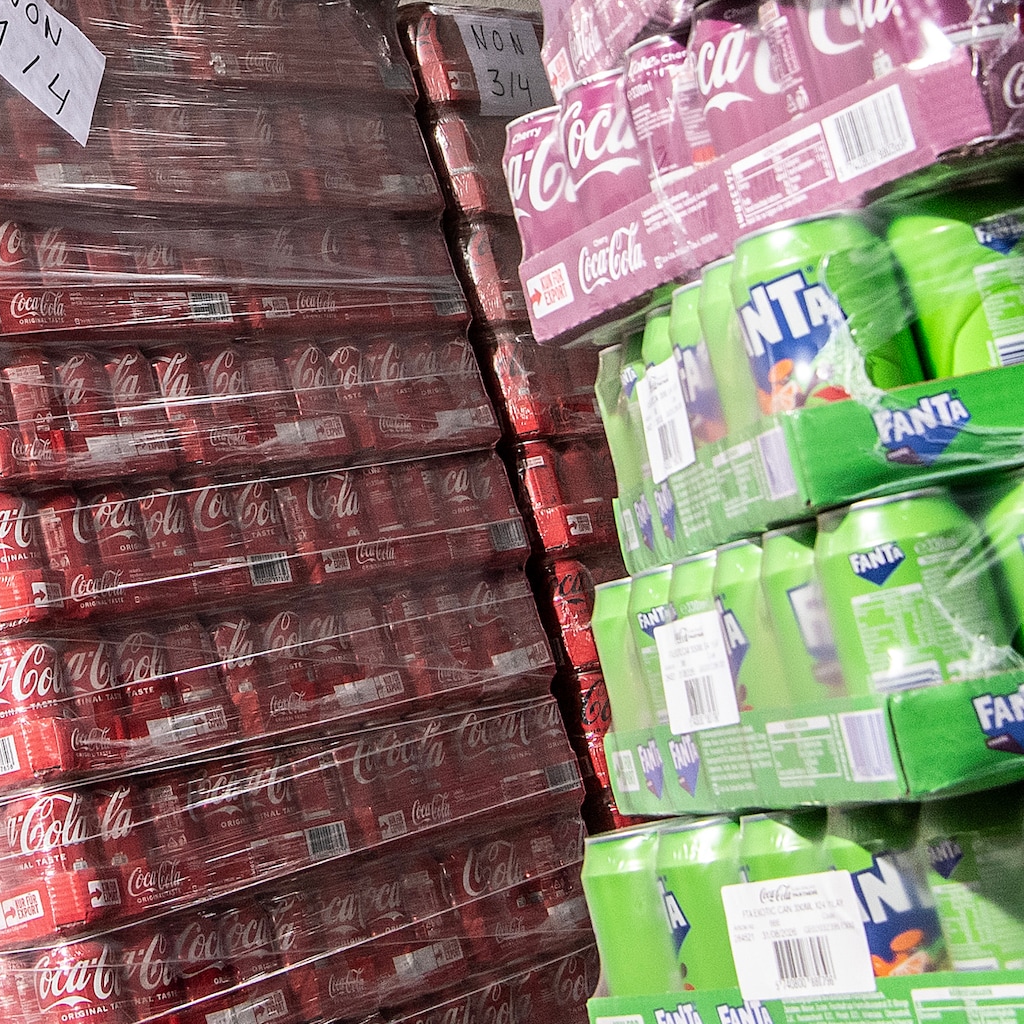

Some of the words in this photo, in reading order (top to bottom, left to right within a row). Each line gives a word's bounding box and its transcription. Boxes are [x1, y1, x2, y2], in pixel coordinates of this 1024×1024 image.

[471, 25, 525, 57] NON
[512, 126, 542, 145] Cherry
[578, 222, 647, 295] Coca-Cola
[10, 292, 66, 320] Coca-Cola
[544, 282, 568, 306] EXPORT
[873, 392, 970, 444] FANTA
[849, 544, 903, 574] FANTA
[16, 903, 40, 917] EXPORT
